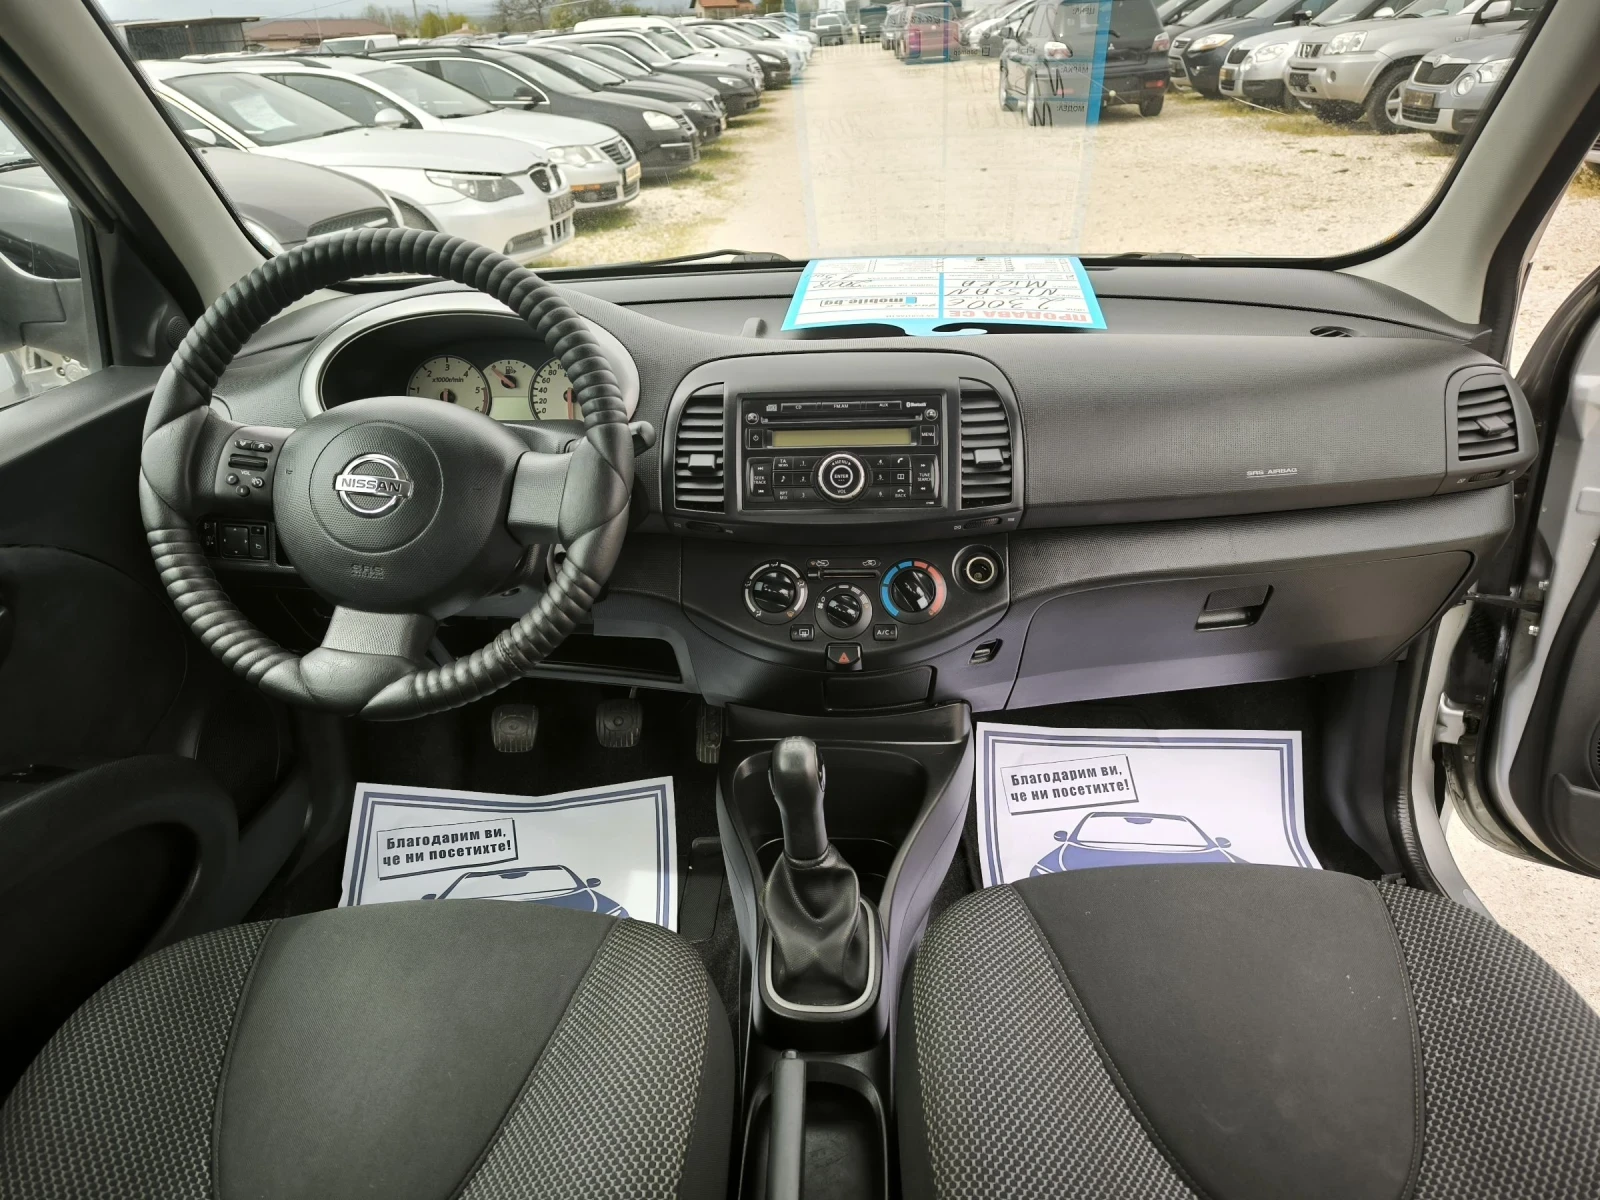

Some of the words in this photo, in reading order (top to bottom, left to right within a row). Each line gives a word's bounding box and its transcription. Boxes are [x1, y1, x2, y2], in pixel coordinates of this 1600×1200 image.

[944, 288, 1057, 296] NISSAN
[822, 297, 904, 307] mobile.bg
[982, 310, 1088, 322] ПРОДАВА
[341, 478, 402, 493] NISSAN
[1010, 767, 1098, 786] Благодарим
[1100, 765, 1122, 776] ви,
[1010, 792, 1027, 802] че
[1032, 790, 1048, 800] ни
[1052, 779, 1130, 798] посетихте!
[386, 830, 480, 850] Благодарим
[484, 828, 506, 838] ви,
[382, 854, 400, 866] че
[406, 852, 424, 864] ни
[430, 840, 512, 860] посетихте!
